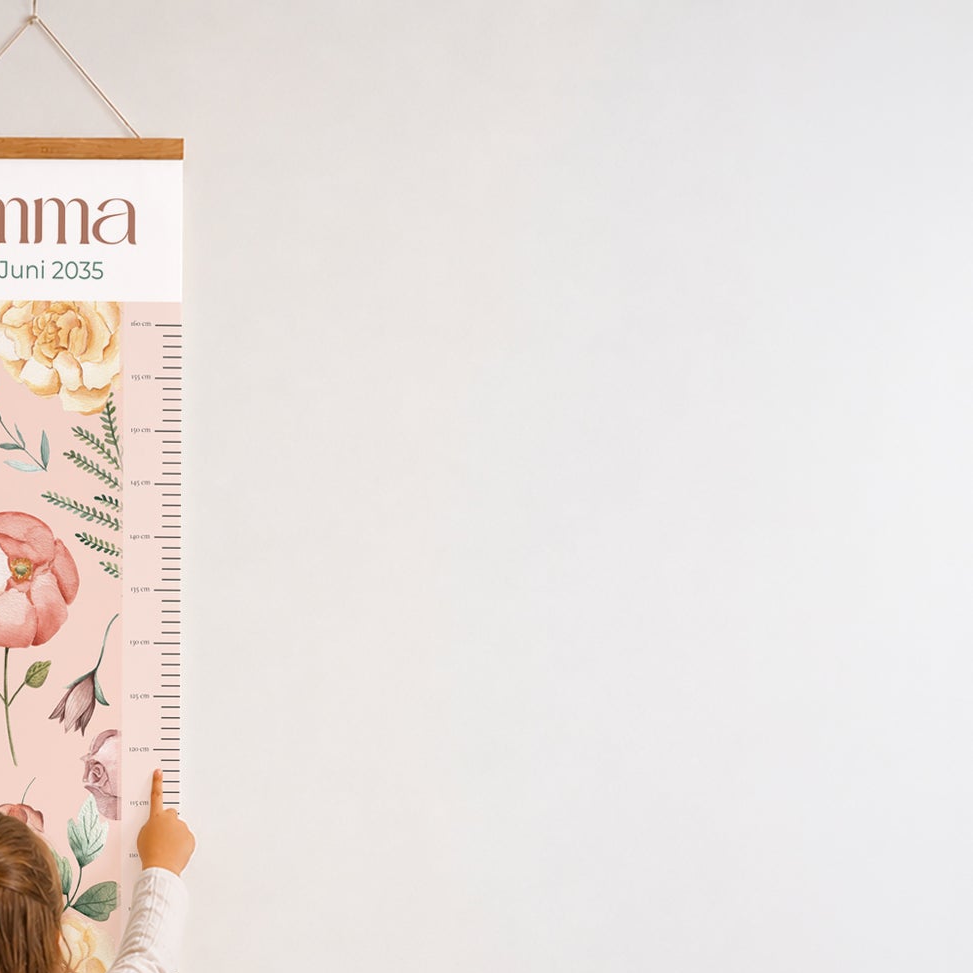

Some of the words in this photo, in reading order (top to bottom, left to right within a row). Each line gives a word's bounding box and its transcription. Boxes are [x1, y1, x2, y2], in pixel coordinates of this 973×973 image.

[51, 260, 104, 281] 2035
[130, 374, 140, 382] 155
[130, 427, 140, 435] 150
[130, 479, 140, 488] 145
[130, 586, 140, 594] 135
[130, 639, 140, 648] 130
[130, 693, 140, 701] 125
